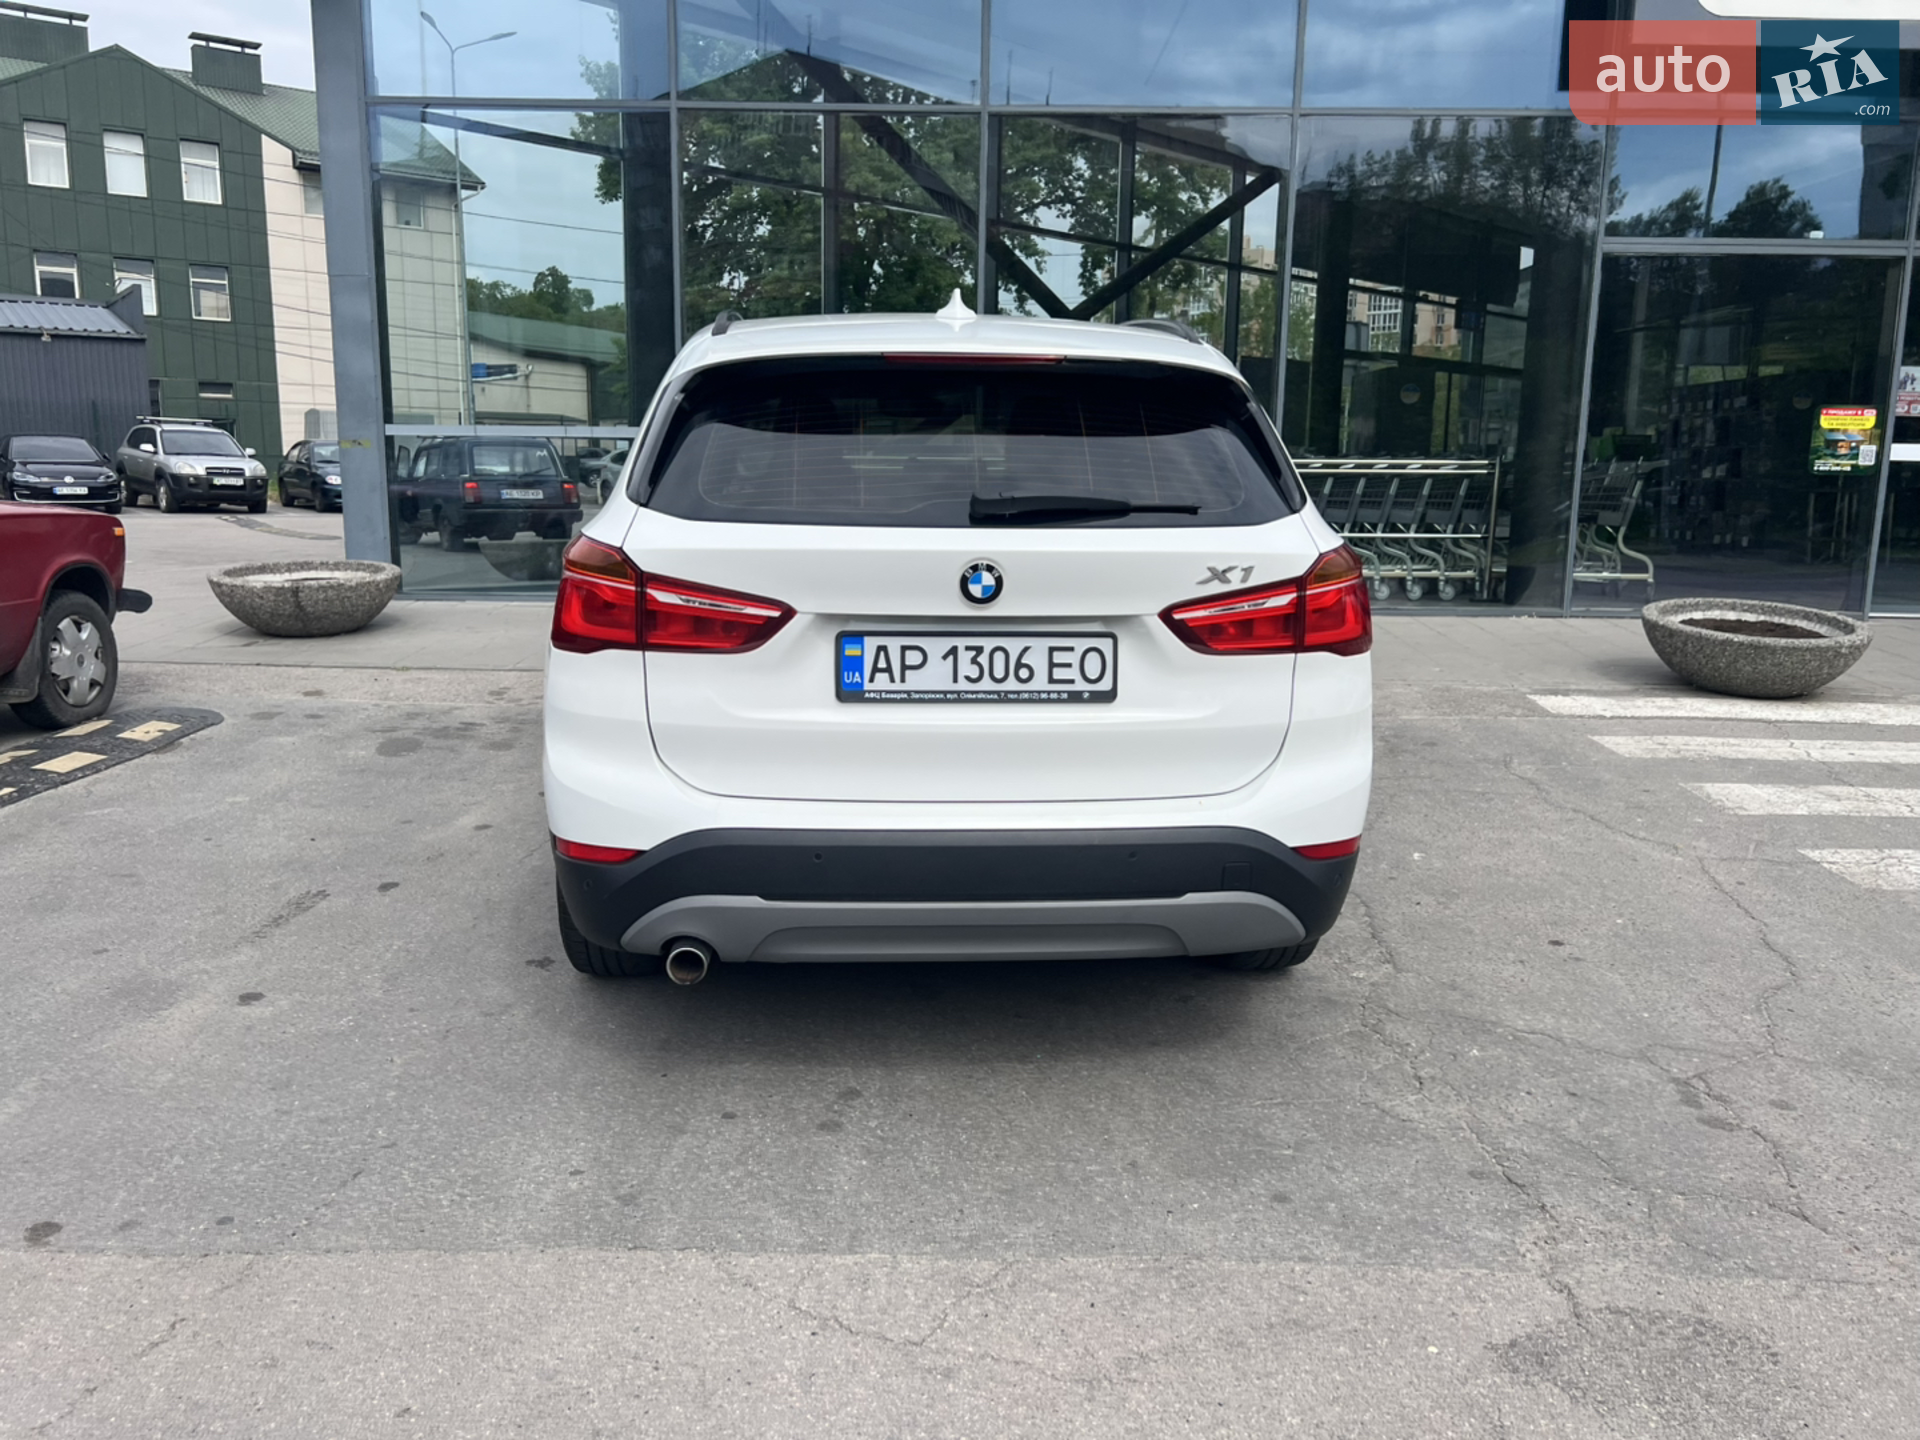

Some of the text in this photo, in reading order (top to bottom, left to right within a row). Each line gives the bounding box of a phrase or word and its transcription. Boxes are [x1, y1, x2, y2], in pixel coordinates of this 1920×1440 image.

[964, 562, 1000, 578] BMW
[1196, 565, 1256, 585] X1
[868, 645, 1107, 684] AP 1306 EO
[844, 672, 862, 684] UA
